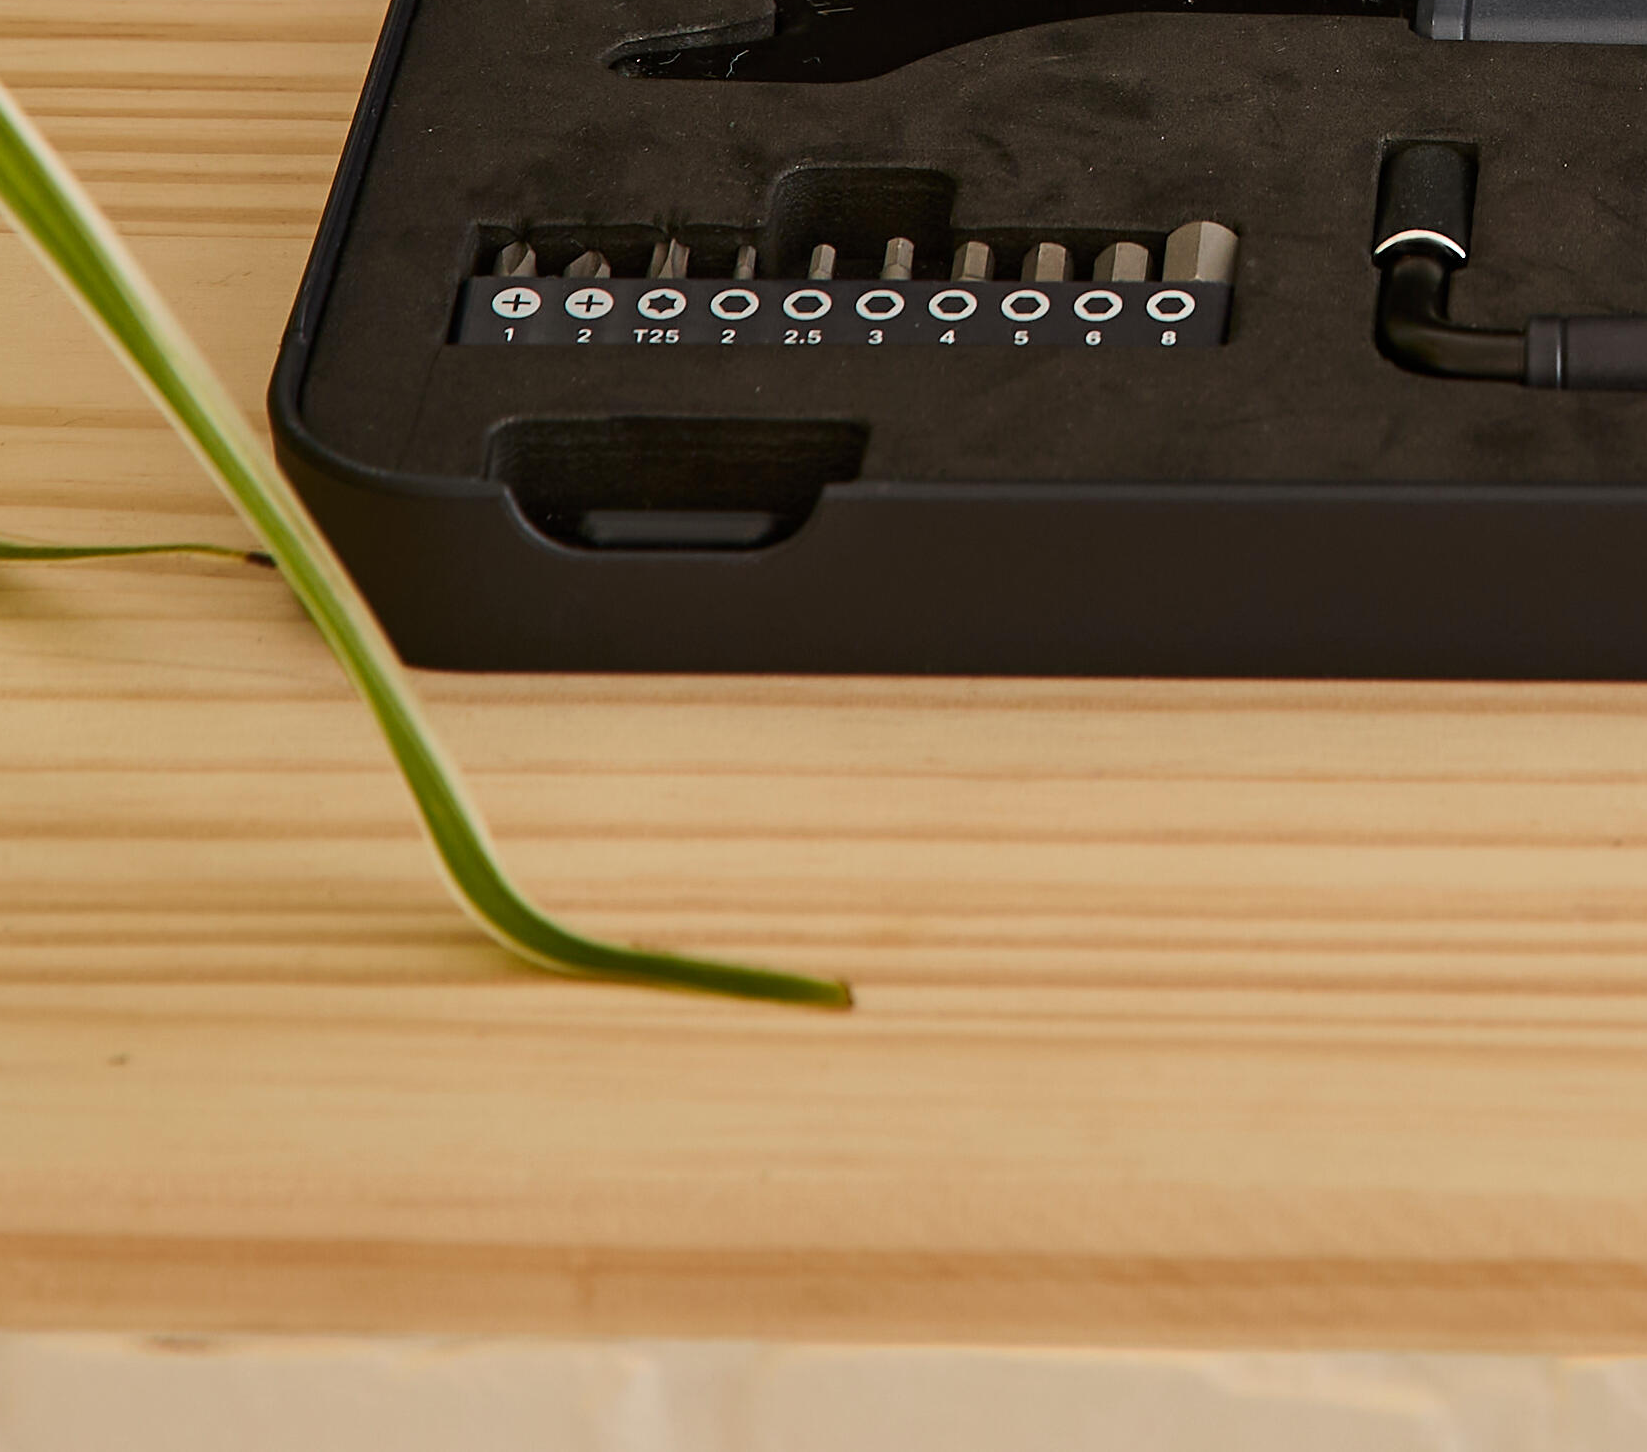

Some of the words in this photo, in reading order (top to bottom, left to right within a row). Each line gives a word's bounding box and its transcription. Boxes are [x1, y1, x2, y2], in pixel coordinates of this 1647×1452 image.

[503, 327, 515, 342] 1
[576, 328, 592, 343] 2
[632, 328, 681, 344] T25
[720, 329, 736, 344] 2
[783, 329, 822, 345] 2.5
[867, 330, 884, 345] 3
[939, 330, 955, 345] 4
[1013, 330, 1030, 346] 5
[1084, 330, 1102, 346] 6
[1160, 330, 1177, 346] 8
